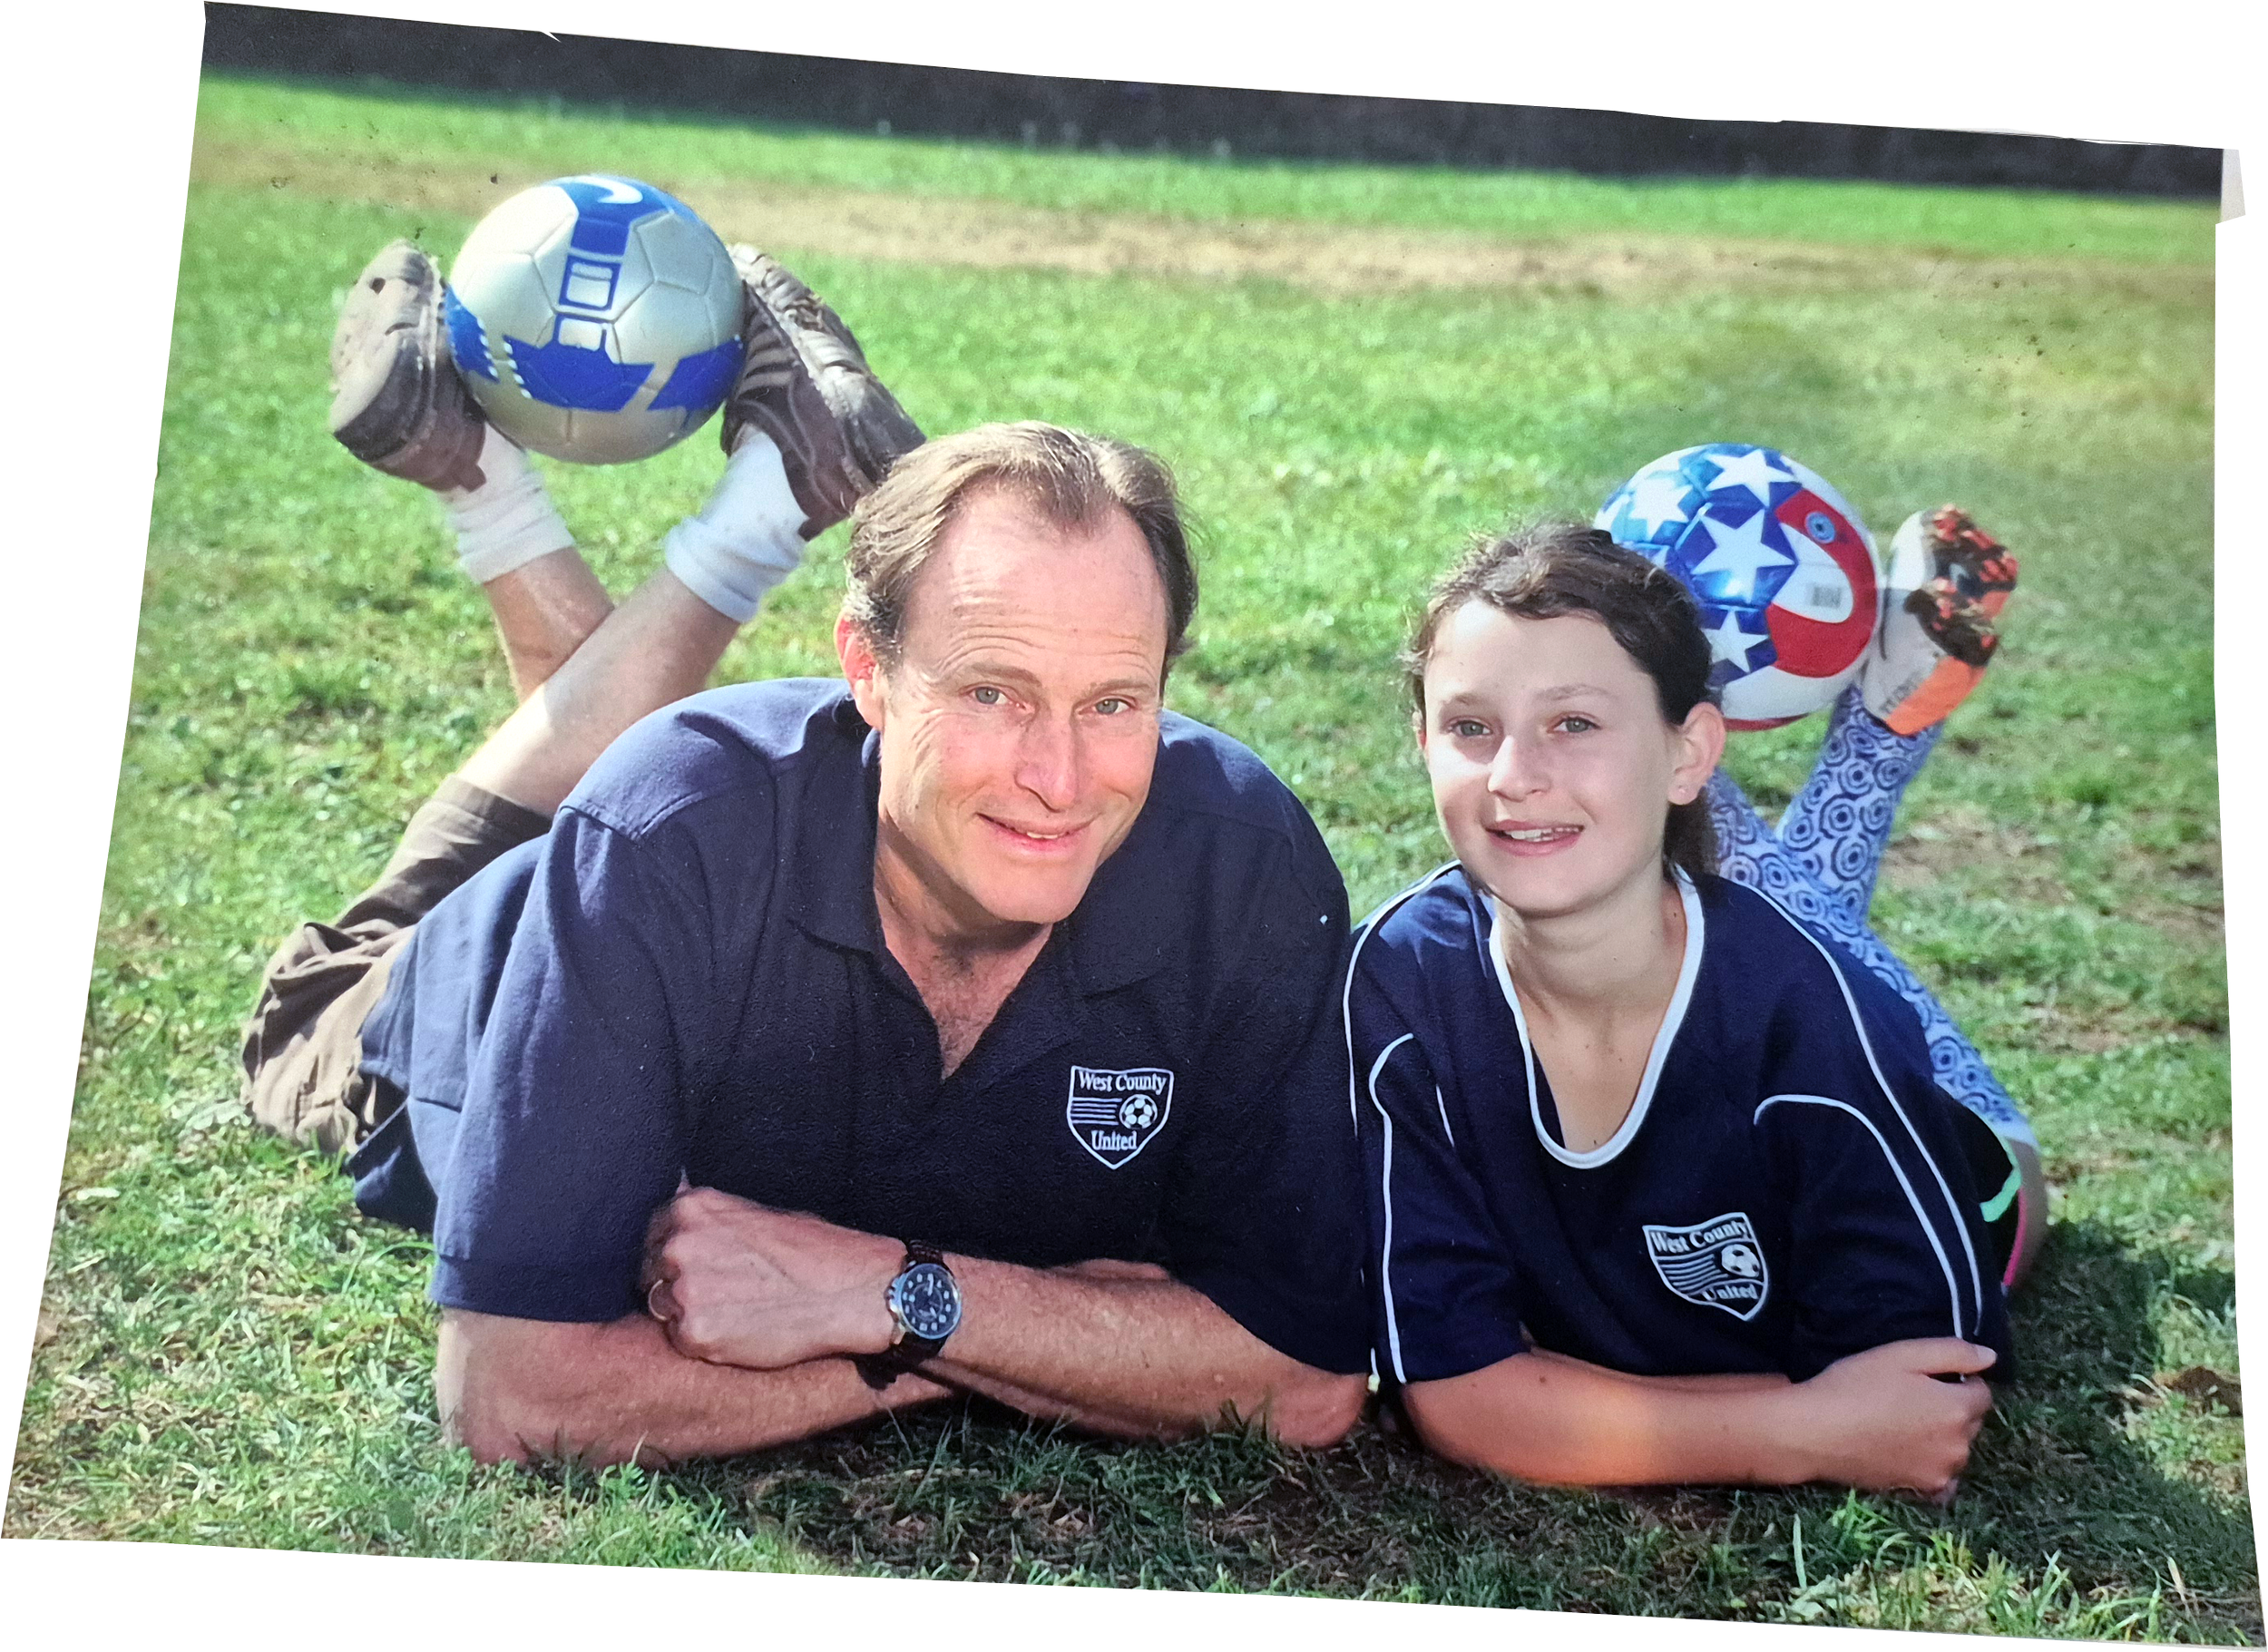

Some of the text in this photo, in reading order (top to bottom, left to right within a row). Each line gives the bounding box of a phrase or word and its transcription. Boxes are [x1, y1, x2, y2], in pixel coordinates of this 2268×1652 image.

[1078, 1070, 1168, 1095] West County
[1090, 1129, 1138, 1151] United
[1650, 1220, 1749, 1254] West County
[1702, 1283, 1759, 1302] United
